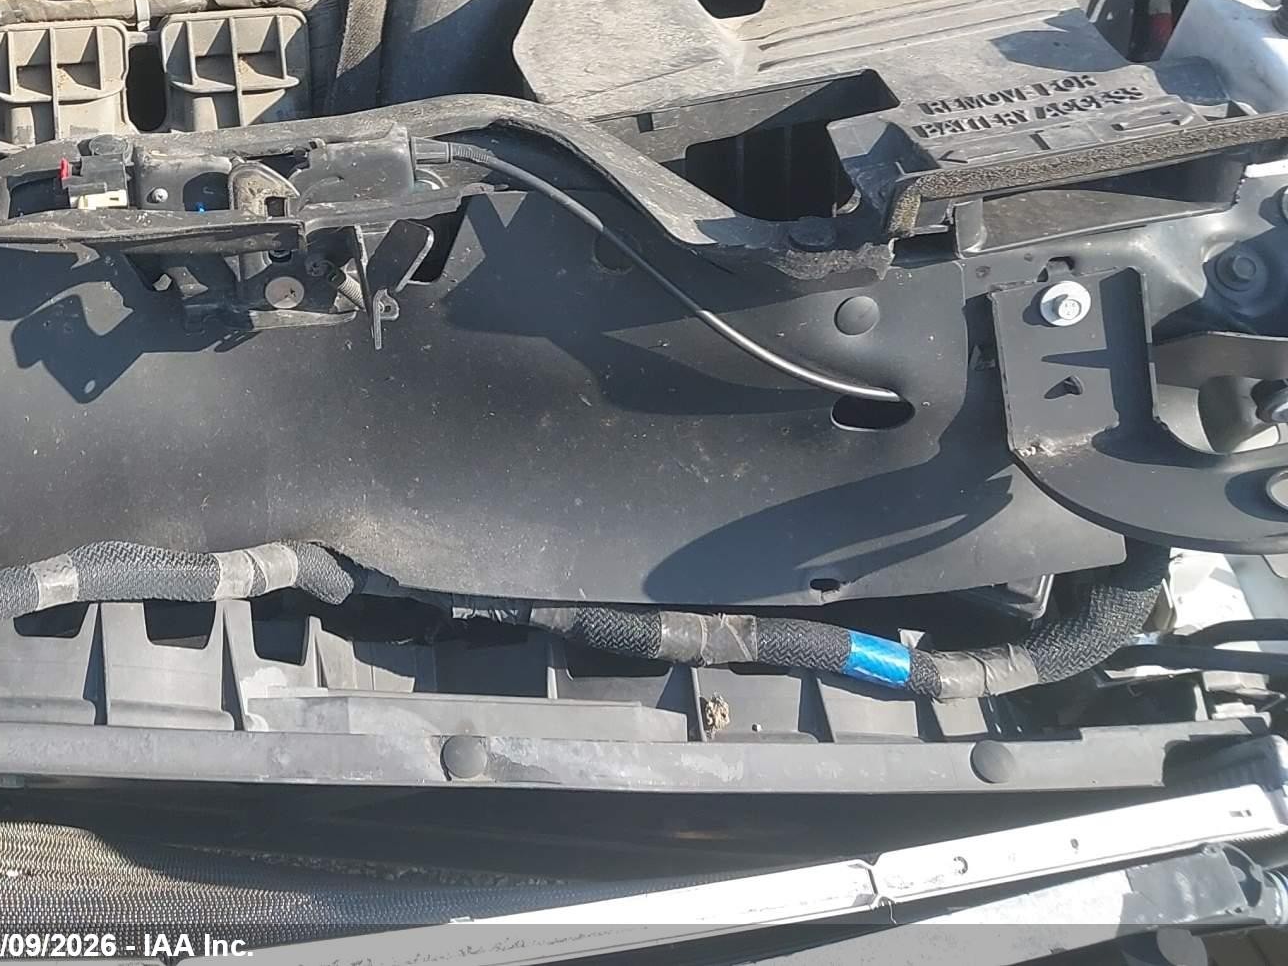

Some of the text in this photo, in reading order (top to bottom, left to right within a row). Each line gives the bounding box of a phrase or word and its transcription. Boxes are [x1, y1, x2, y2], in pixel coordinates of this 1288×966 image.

[1040, 74, 1097, 97] FOR
[915, 86, 1144, 138] BATTERY ACCESS
